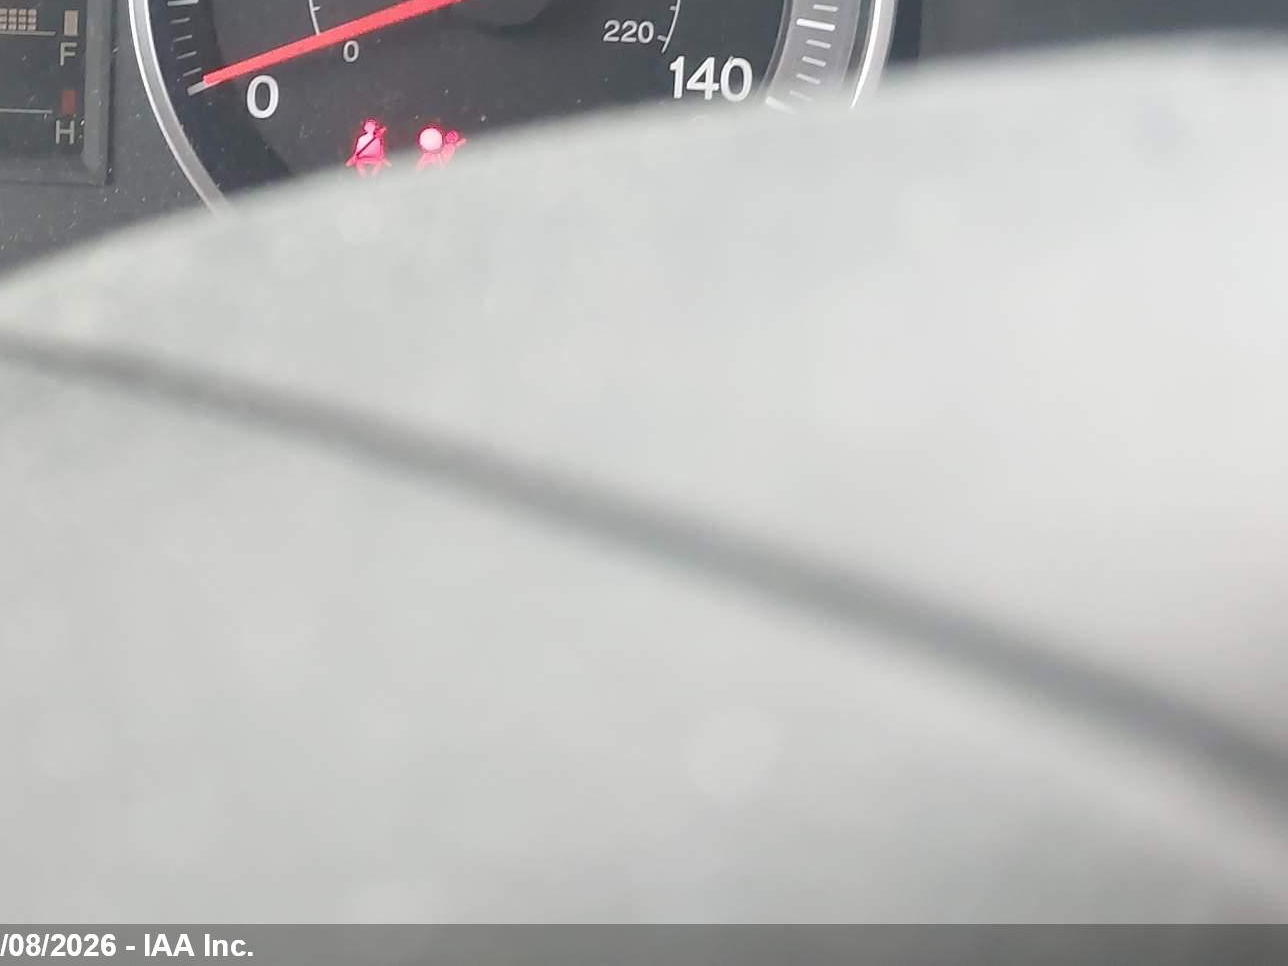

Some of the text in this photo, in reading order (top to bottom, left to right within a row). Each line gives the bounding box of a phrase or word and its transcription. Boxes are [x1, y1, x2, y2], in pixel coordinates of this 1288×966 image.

[603, 20, 655, 44] 220
[59, 42, 78, 67] F
[342, 40, 360, 64] 0
[669, 56, 754, 102] 140
[246, 74, 280, 119] 0
[55, 119, 76, 145] H
